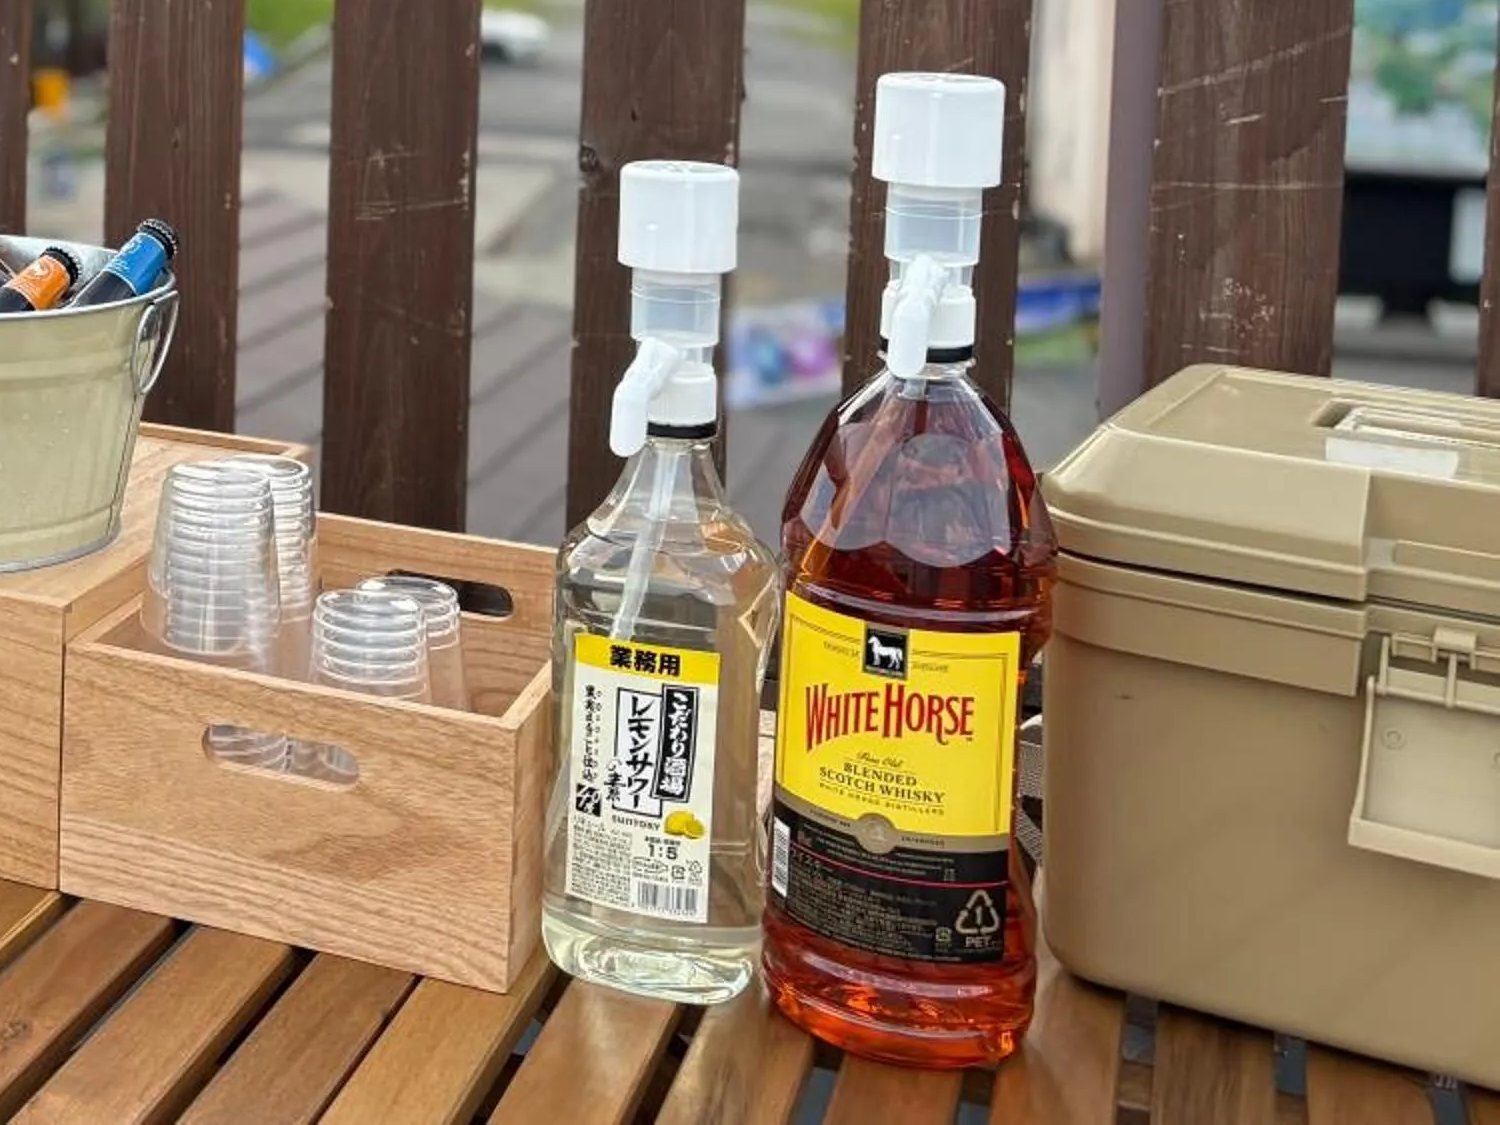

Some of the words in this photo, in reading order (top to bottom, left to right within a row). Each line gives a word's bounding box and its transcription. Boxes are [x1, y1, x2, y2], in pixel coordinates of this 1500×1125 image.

[610, 644, 681, 676] 業務用
[805, 682, 880, 753] WHITE
[882, 682, 975, 747] HORSE
[624, 695, 656, 809] レモンサワー
[819, 765, 877, 794] SCOTCH
[879, 782, 946, 804] WHISKY
[842, 761, 918, 786] BLENDED
[965, 935, 992, 949] PET
